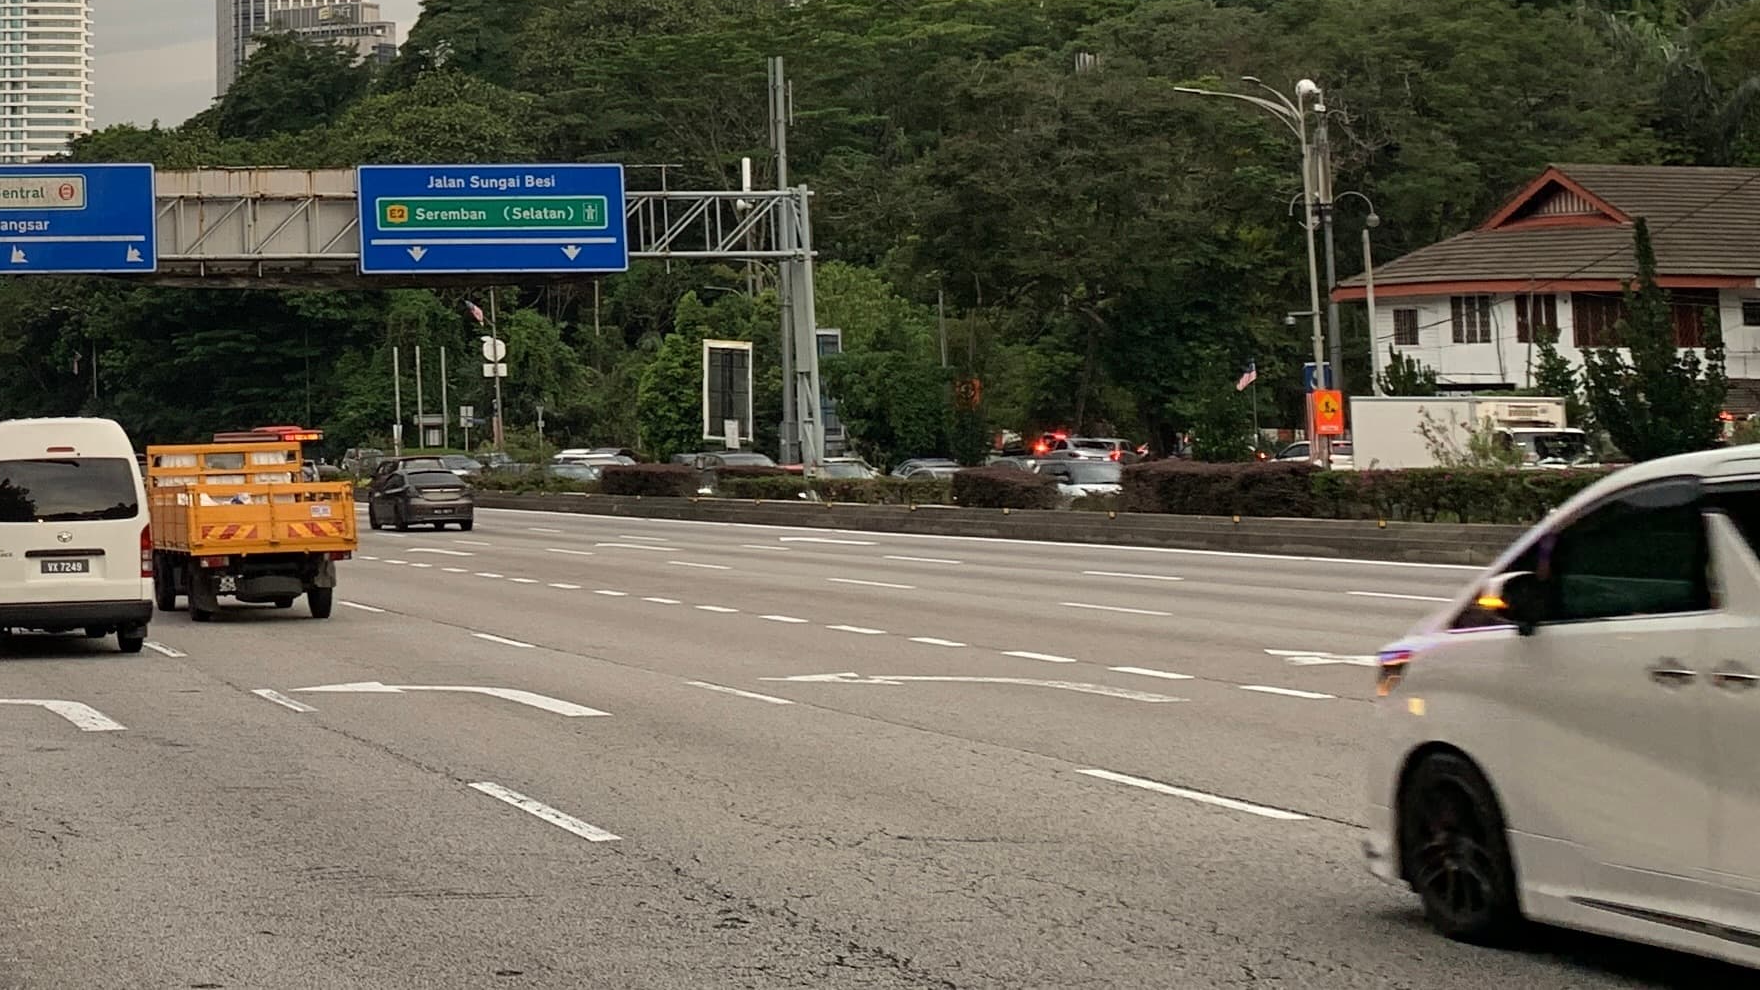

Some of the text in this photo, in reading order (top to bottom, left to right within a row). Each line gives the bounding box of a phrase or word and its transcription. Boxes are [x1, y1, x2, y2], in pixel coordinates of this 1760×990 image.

[427, 175, 556, 190] Jalan Sungai Besi
[415, 207, 487, 221] Seremban
[47, 562, 82, 572] VX 7249
